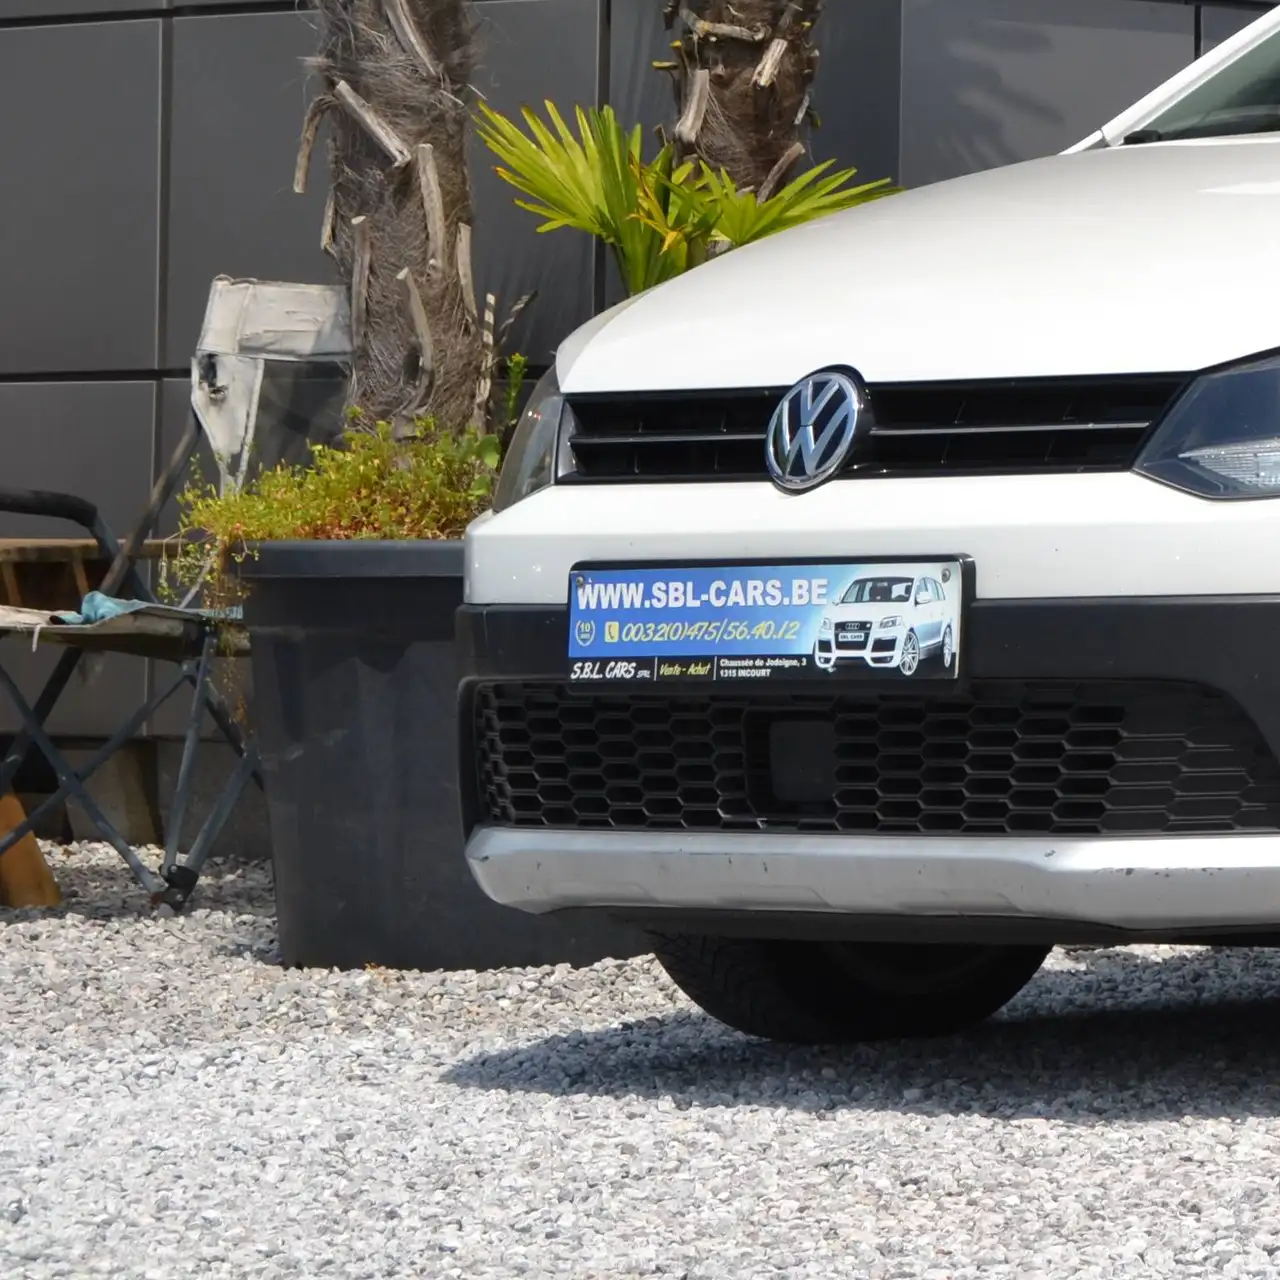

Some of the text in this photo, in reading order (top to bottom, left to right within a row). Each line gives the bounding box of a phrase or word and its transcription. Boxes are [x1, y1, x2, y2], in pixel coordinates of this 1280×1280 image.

[576, 578, 829, 610] WWW.SBL-CARS.BE
[622, 619, 800, 644] 0032(0)475/56.40.12
[659, 663, 682, 676] Vente
[754, 657, 765, 667] de
[605, 661, 637, 679] CARS
[719, 668, 772, 678] 1315 INCOURT
